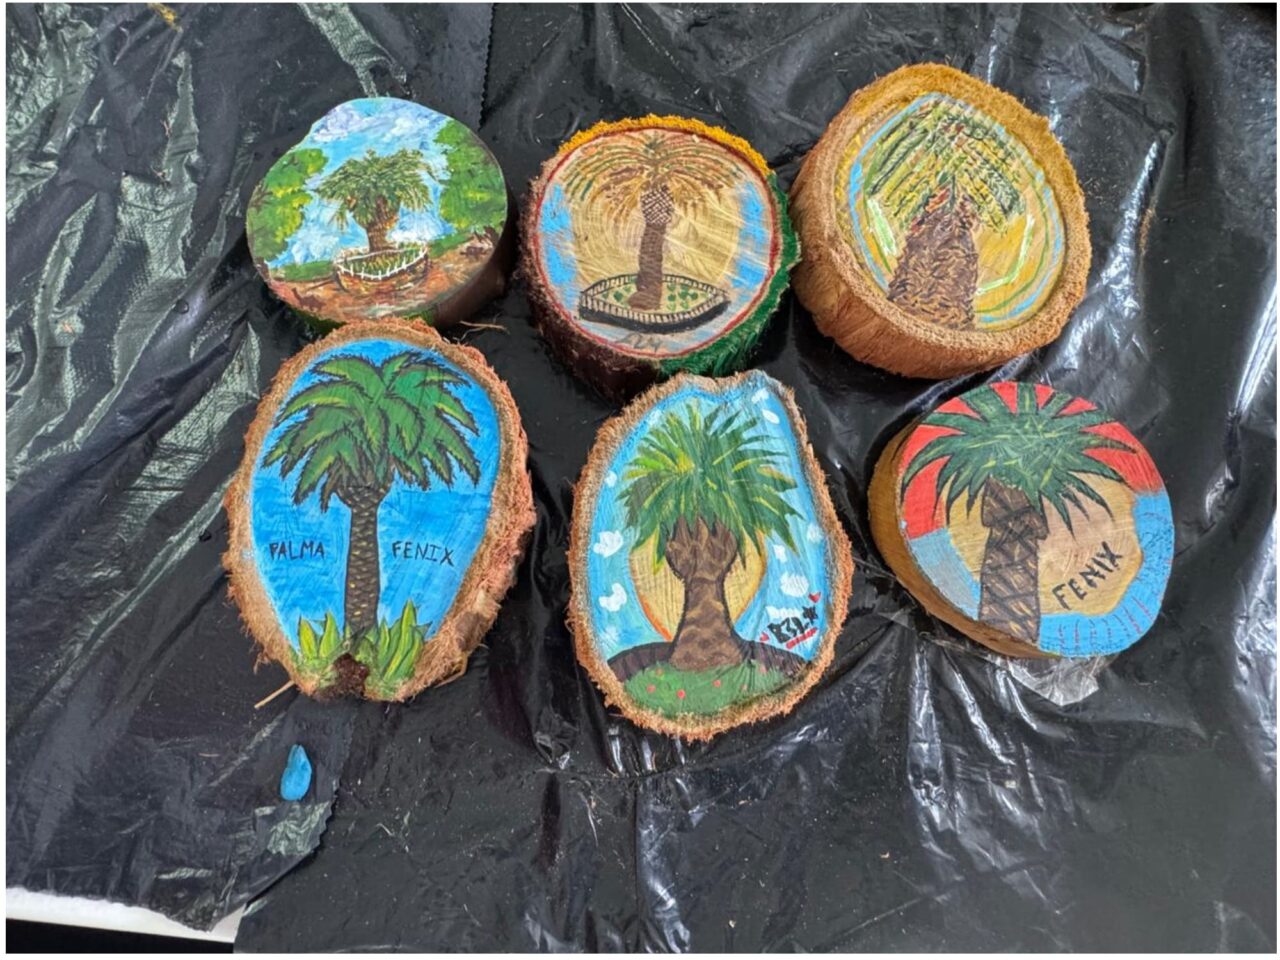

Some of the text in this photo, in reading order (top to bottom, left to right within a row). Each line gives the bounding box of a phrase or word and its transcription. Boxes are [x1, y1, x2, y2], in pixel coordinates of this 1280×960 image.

[269, 541, 454, 567] PALMA FENIX
[1052, 541, 1123, 611] FENIX
